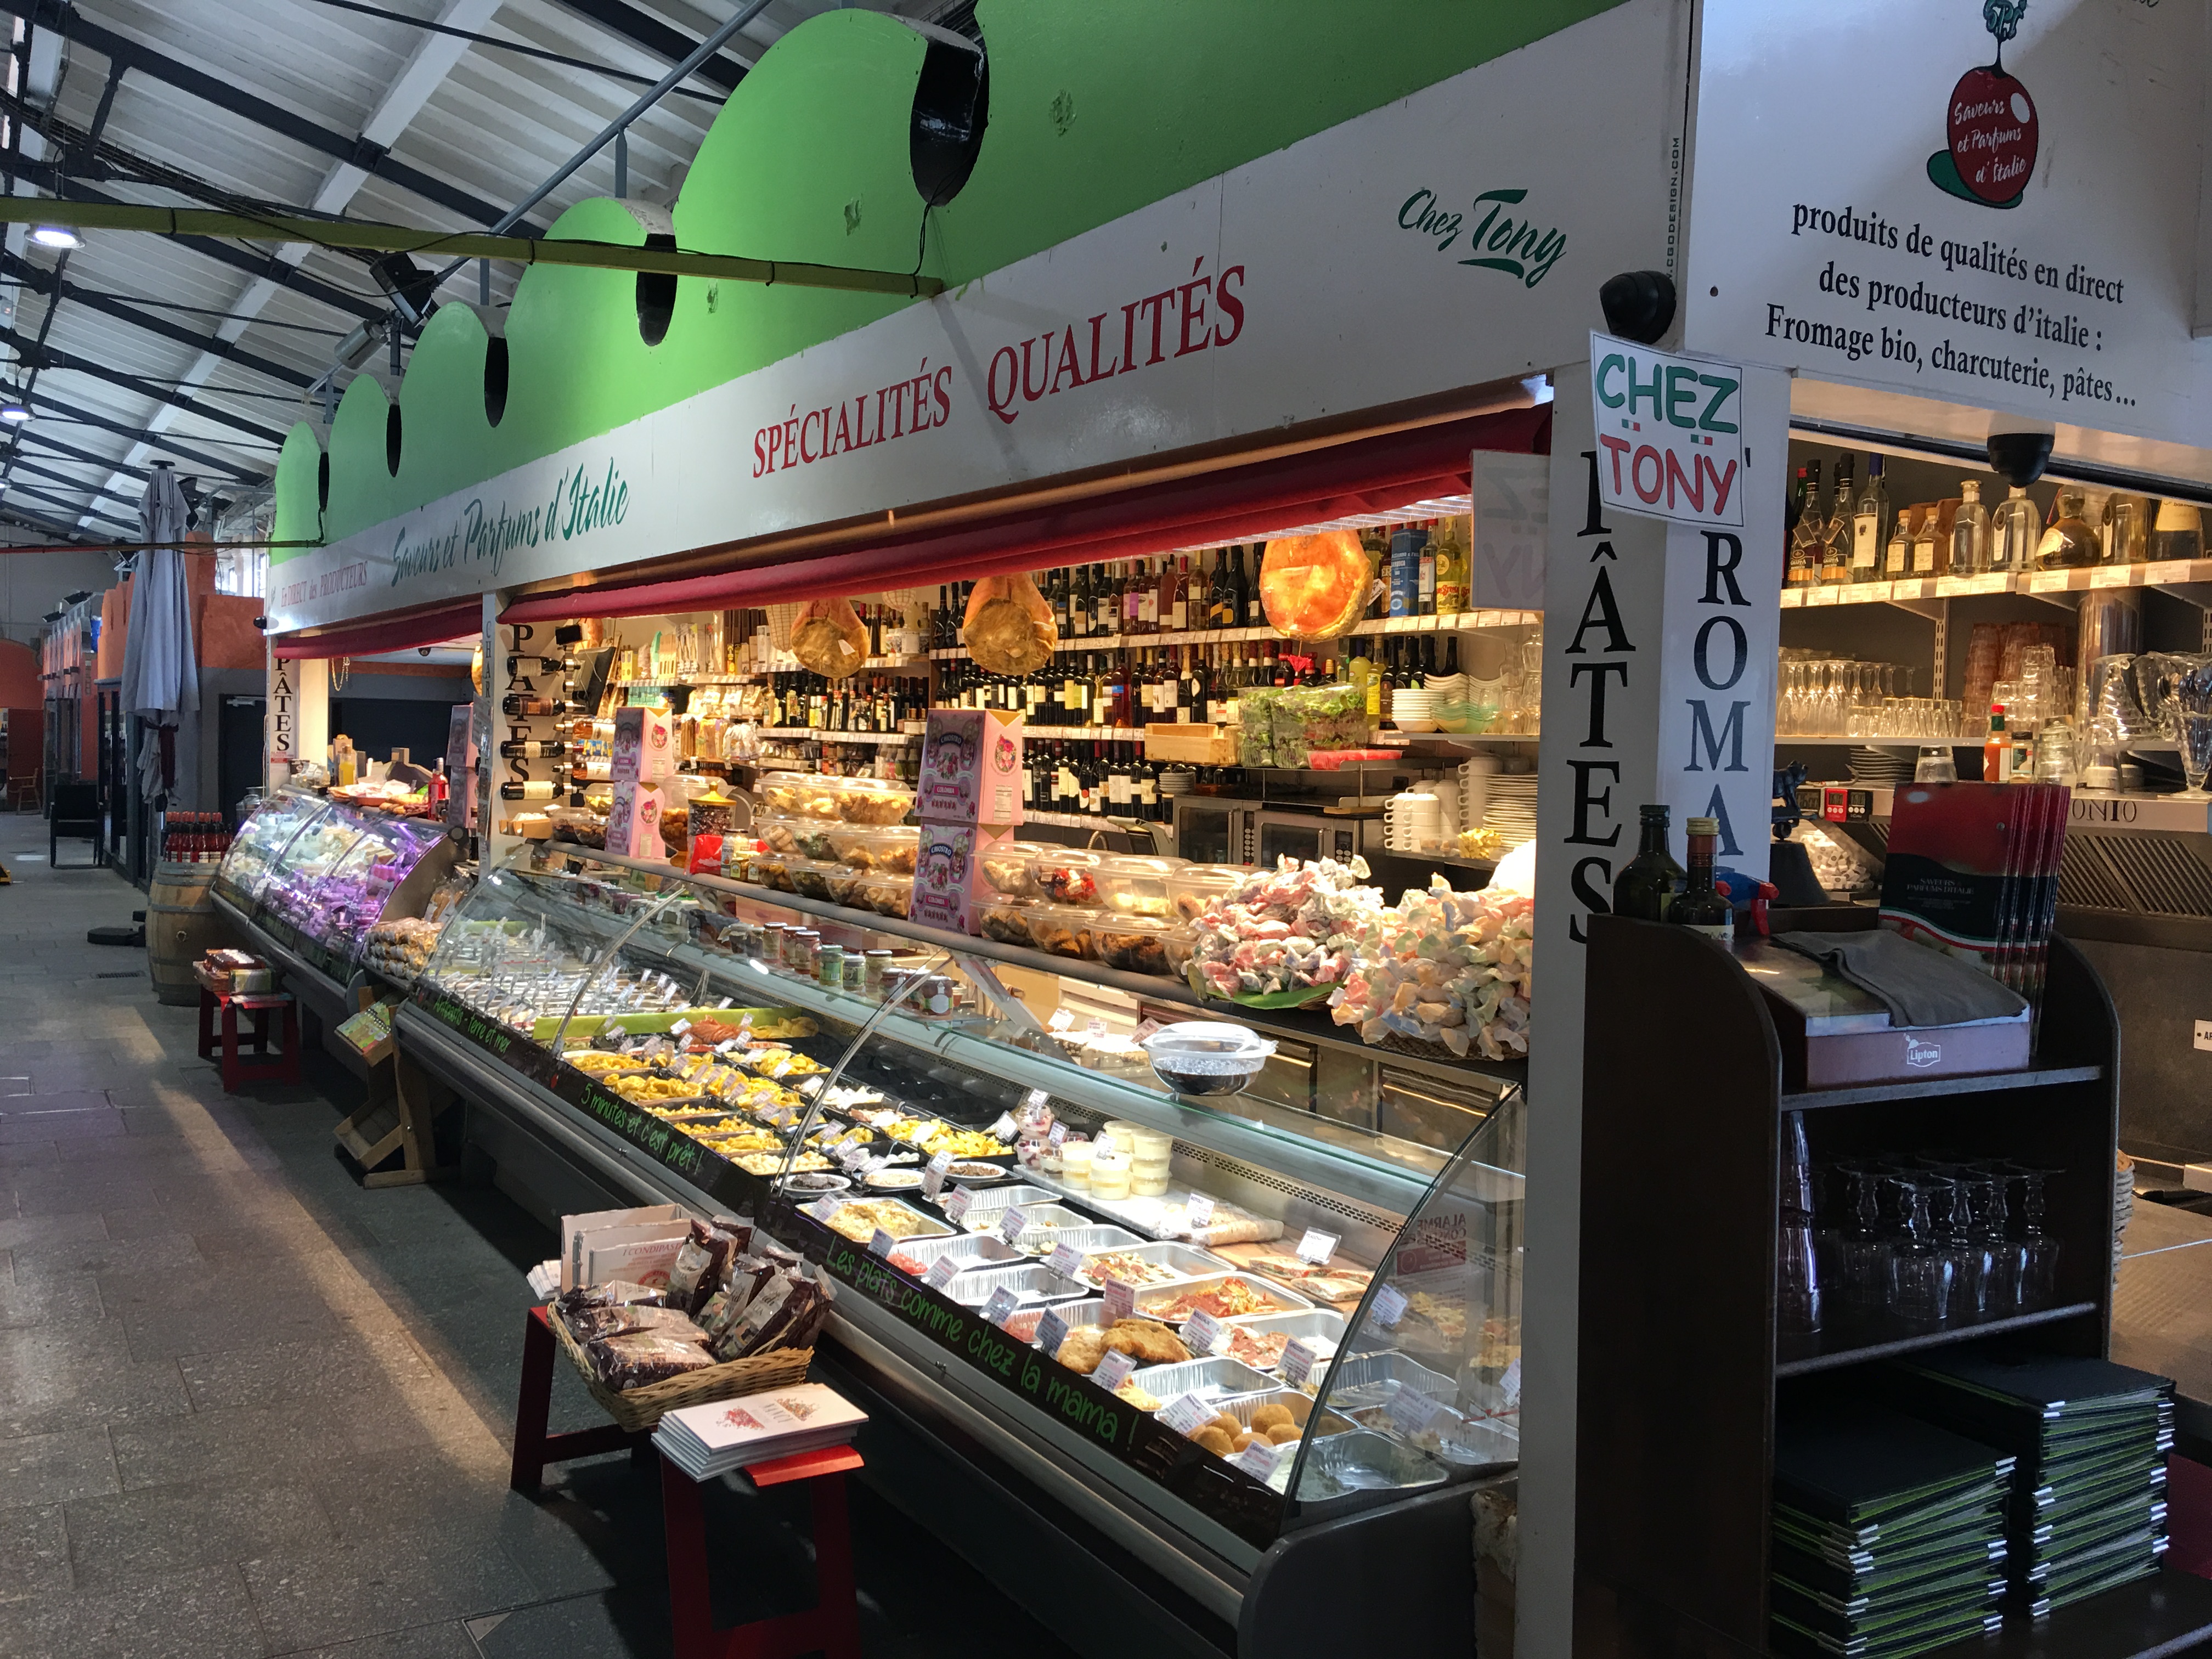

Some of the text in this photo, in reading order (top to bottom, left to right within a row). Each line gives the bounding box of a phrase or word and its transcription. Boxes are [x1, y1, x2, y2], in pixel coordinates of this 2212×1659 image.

[1954, 99, 2005, 125] Saveurs
[1957, 127, 2022, 154] et Parfums
[1398, 189, 1567, 289] Chez Tony
[1792, 202, 2124, 303] produits de qualités en direct
[1819, 262, 1860, 298] des
[1867, 274, 2006, 331] producteurs
[752, 256, 1245, 478] SPÉCIALITÉS QUALITÉS
[1764, 303, 1874, 362] Fromage
[1881, 327, 1923, 374] bio,
[1931, 338, 2055, 397] charcuterie,
[1596, 353, 1739, 435] CHEZ
[1600, 433, 1737, 516] TONY
[288, 580, 307, 606] DIRECT
[309, 579, 318, 600] des
[320, 560, 369, 597] PRODUCTEURS
[391, 526, 439, 588] Saveurs
[442, 524, 459, 567] et
[464, 498, 541, 578] Parfums
[273, 658, 293, 752] PÂTES
[2071, 798, 2137, 823] ONIO
[1910, 1047, 1939, 1064] Lipton
[580, 1082, 593, 1105] 5
[590, 1093, 627, 1128] minutes
[627, 1114, 642, 1137] et
[665, 1141, 695, 1171] prêt
[826, 1235, 854, 1278] Les
[854, 1251, 898, 1305] plats
[900, 1284, 962, 1342] comme
[967, 1321, 1017, 1377] chez
[1020, 1353, 1042, 1393] la
[1046, 1376, 1120, 1443] mama
